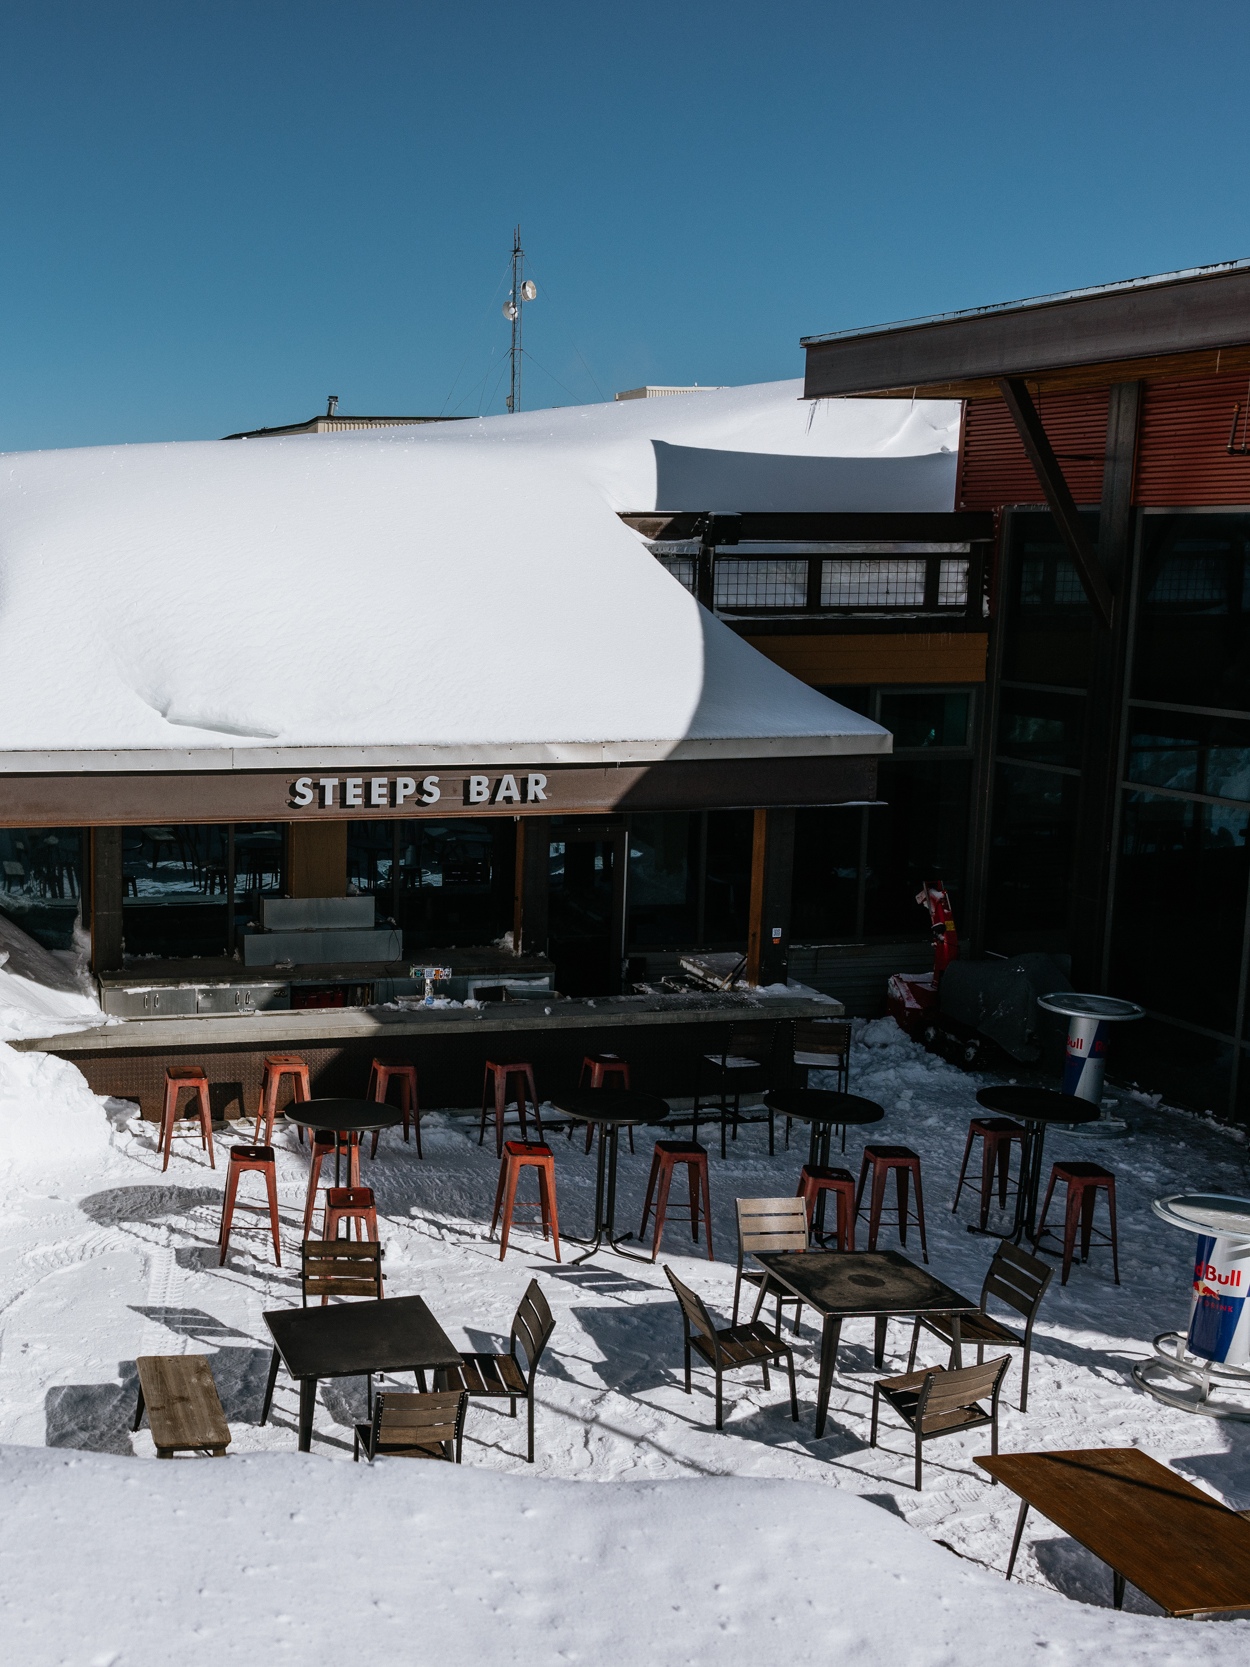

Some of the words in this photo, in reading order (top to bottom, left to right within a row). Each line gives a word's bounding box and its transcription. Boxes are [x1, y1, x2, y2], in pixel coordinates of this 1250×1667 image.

[293, 775, 441, 805] STEEPS
[469, 773, 548, 803] BAR
[1205, 1264, 1241, 1287] Bull
[1204, 1300, 1234, 1313] DRINK
